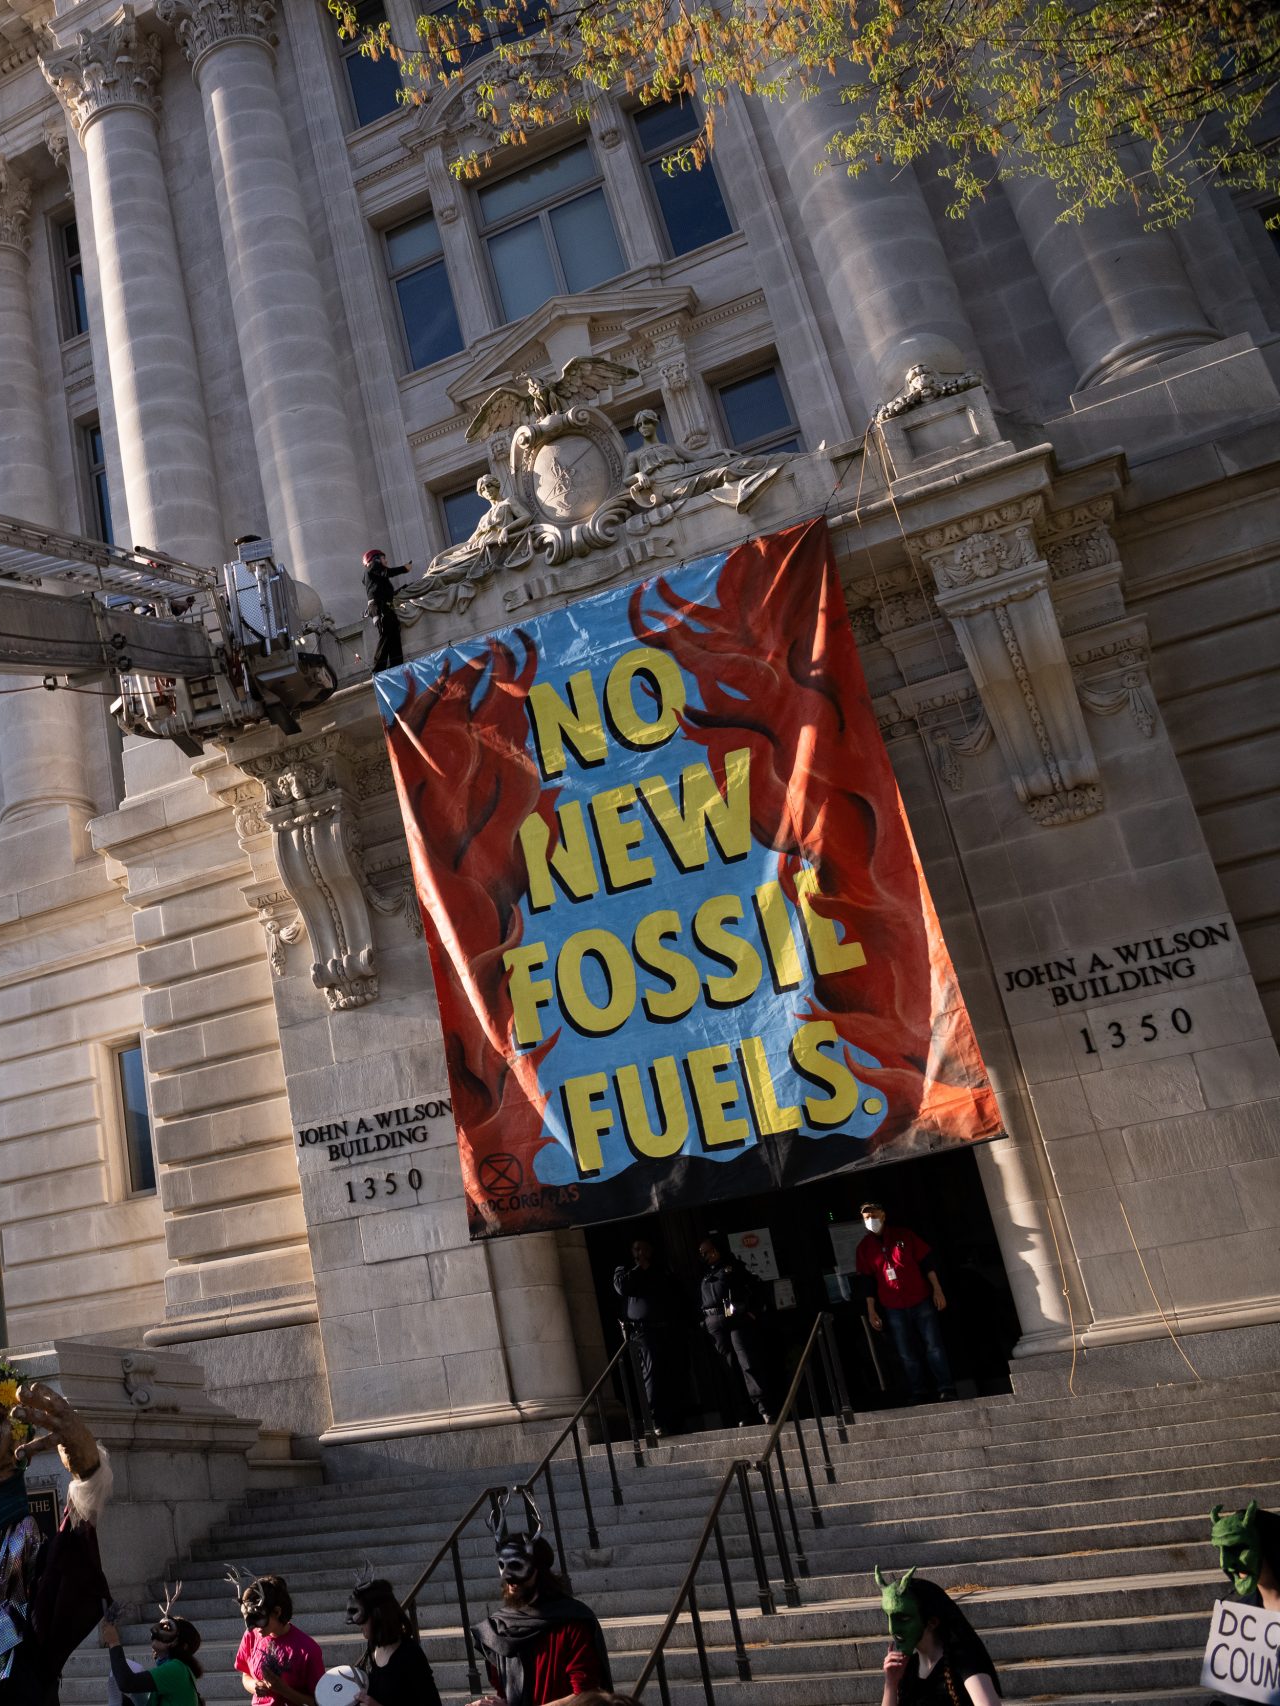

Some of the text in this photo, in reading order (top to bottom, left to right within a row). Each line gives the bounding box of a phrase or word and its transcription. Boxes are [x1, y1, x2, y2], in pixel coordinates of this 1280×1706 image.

[526, 646, 687, 780] NO
[519, 747, 752, 912] NEW
[503, 868, 868, 1047] FOSSIL
[1005, 922, 1231, 992] JOHN A. WILSON
[1050, 957, 1196, 1007] BUILDING
[298, 1098, 454, 1148] JOHN A. WILSON
[564, 1020, 882, 1176] FUELS.
[327, 1125, 428, 1162] BUILDING
[27, 1499, 51, 1513] THE
[1218, 1608, 1257, 1642] DC
